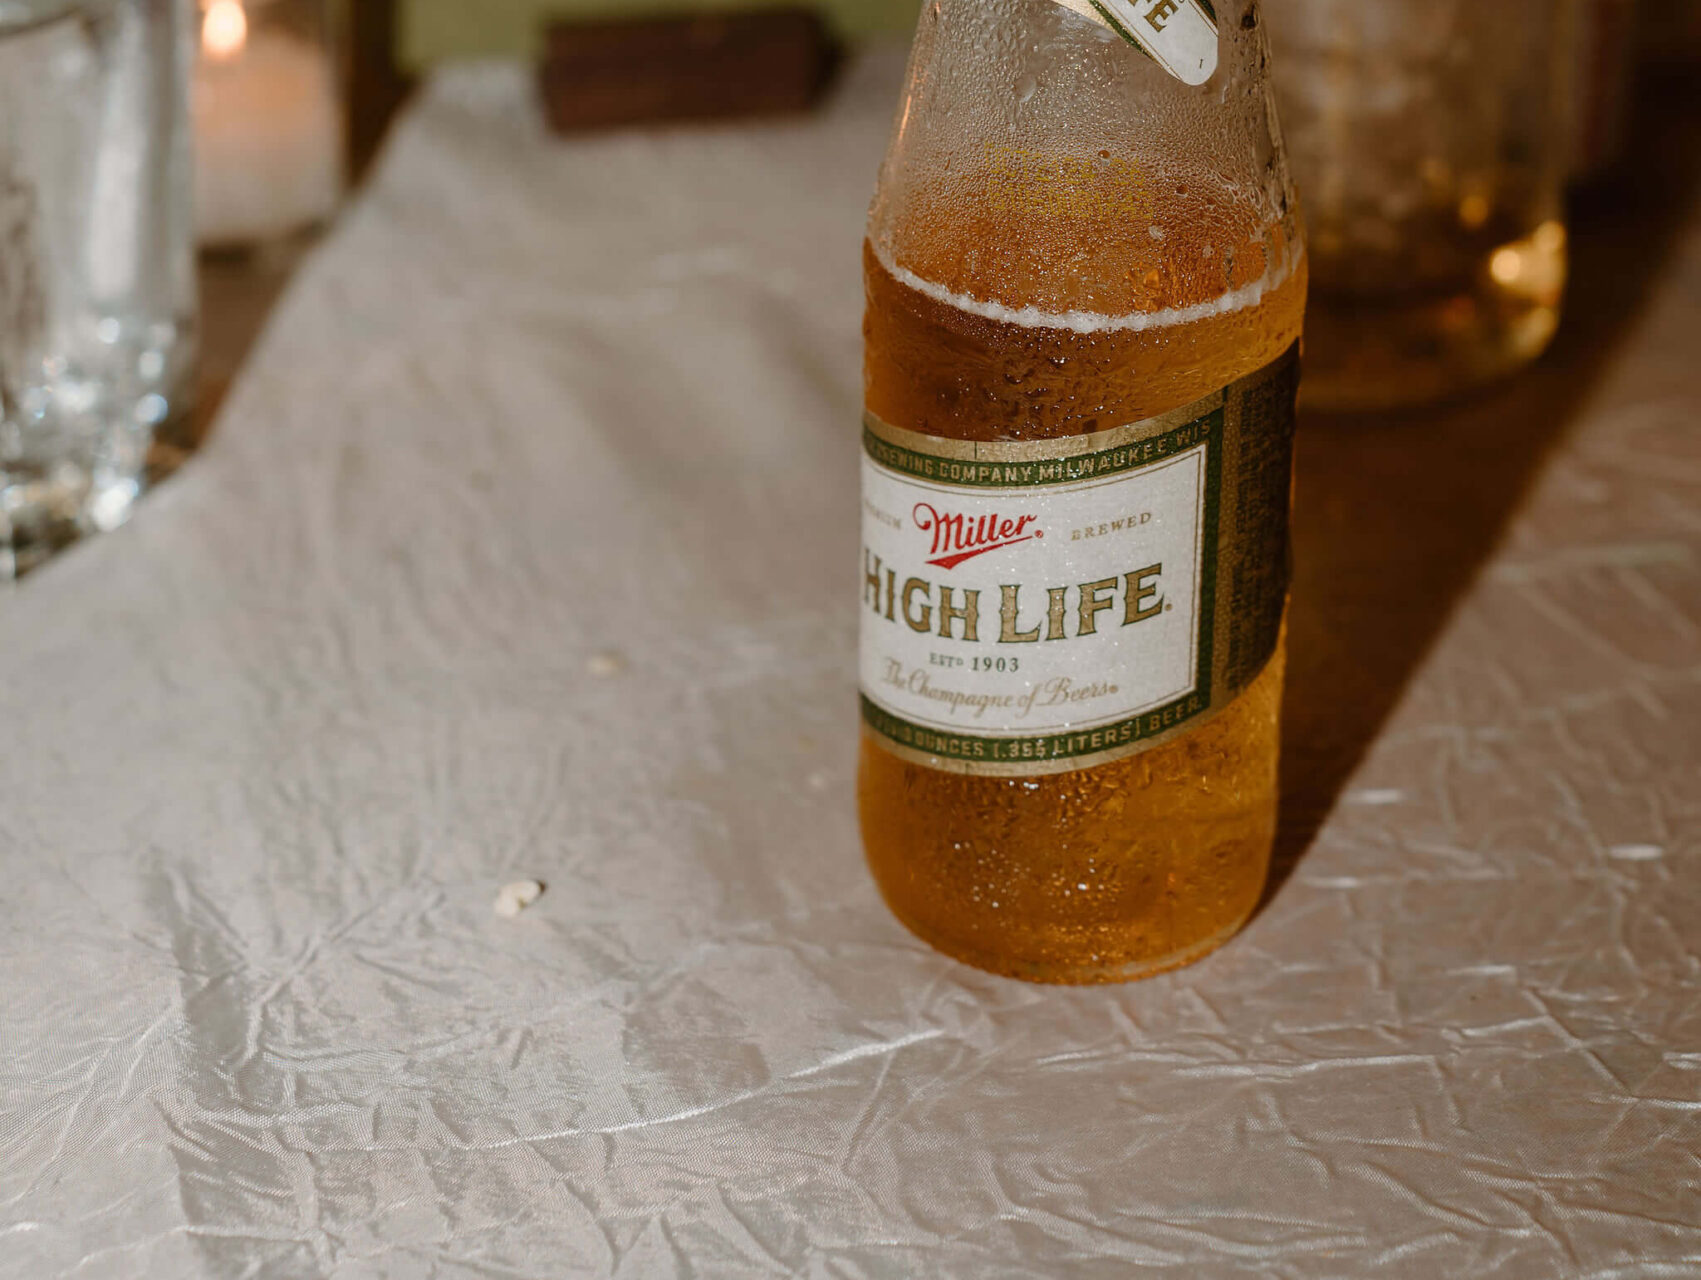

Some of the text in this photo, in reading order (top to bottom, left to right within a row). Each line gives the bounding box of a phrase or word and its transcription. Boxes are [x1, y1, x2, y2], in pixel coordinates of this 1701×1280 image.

[939, 462, 1034, 483] COMPANY
[1037, 436, 1168, 482] MILWAUKEE
[912, 503, 1038, 562] Miller
[1071, 510, 1153, 542] BREWED
[864, 547, 1165, 644] HIGH LIFE
[971, 656, 1020, 673] 1903
[908, 668, 1012, 719] Champagne
[1016, 682, 1042, 720] of
[1036, 676, 1110, 707] Beers
[914, 732, 984, 758] OUNCES
